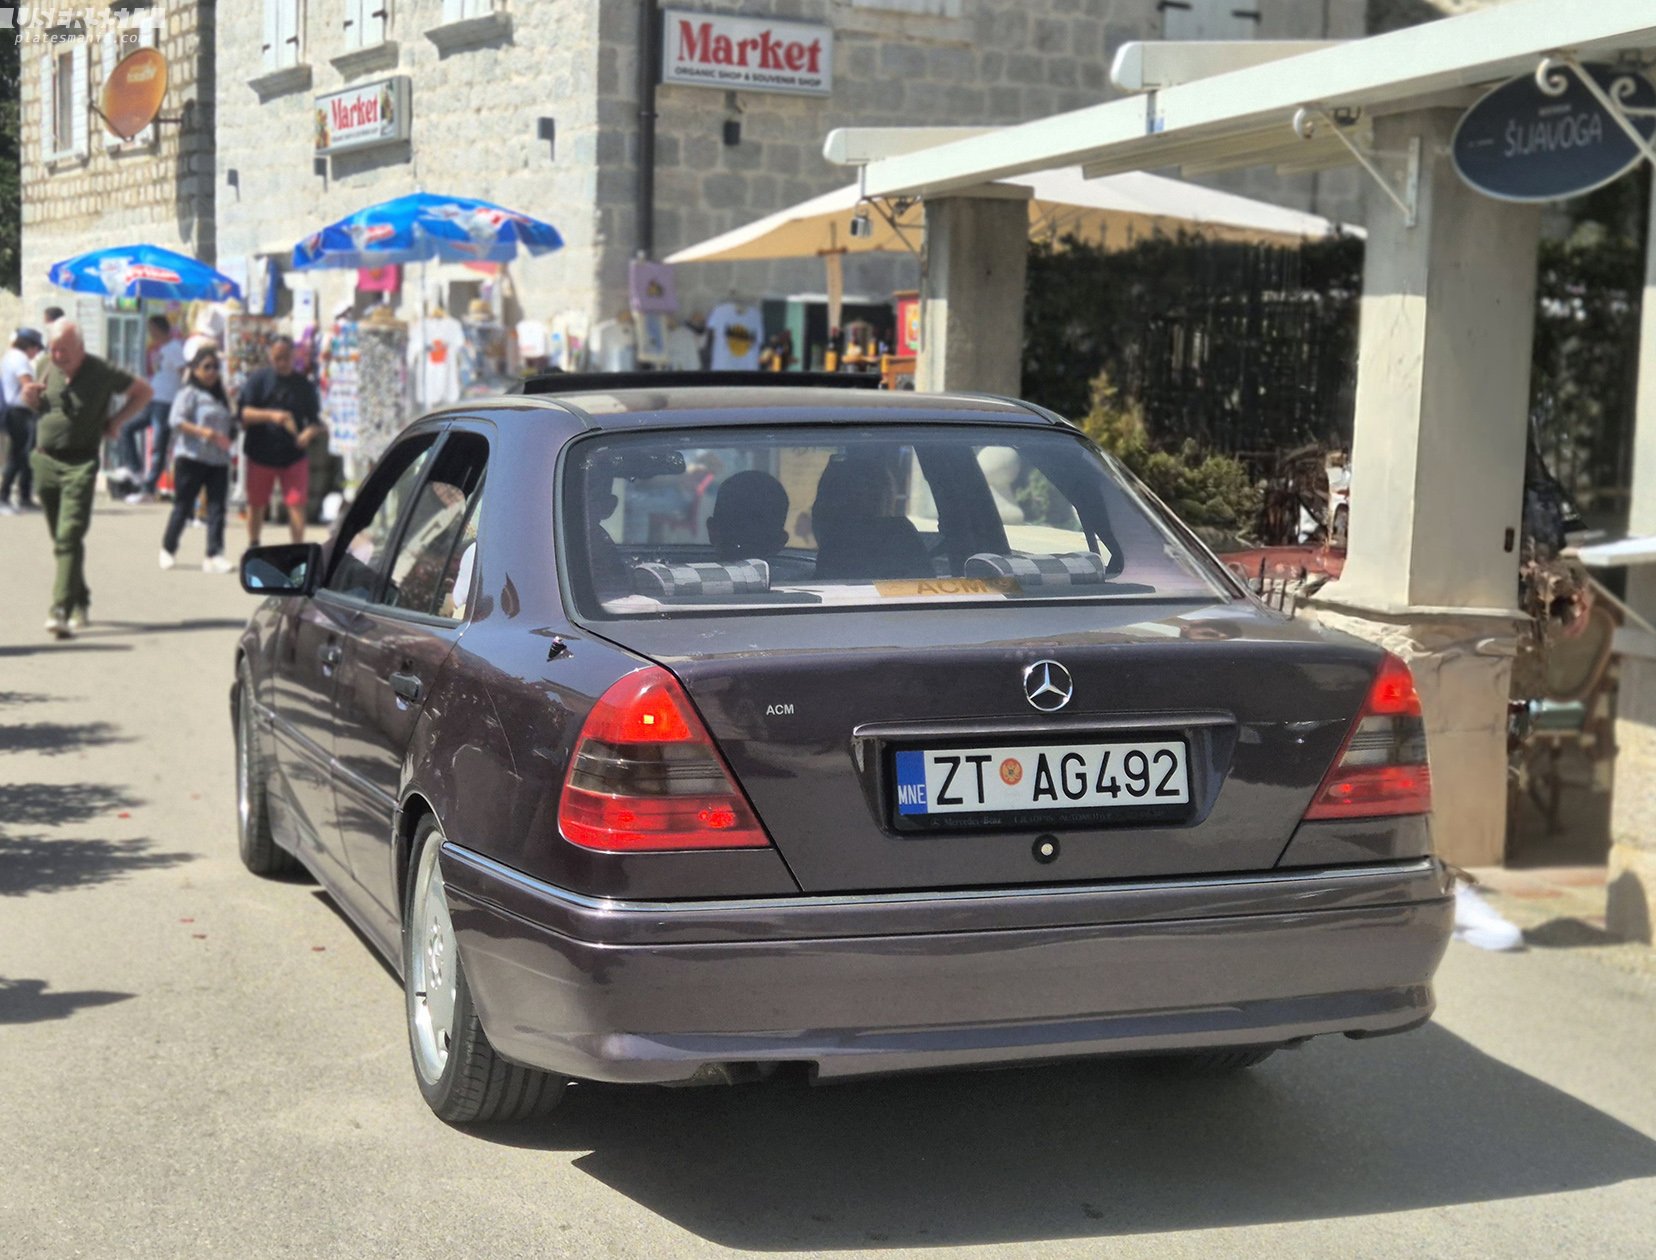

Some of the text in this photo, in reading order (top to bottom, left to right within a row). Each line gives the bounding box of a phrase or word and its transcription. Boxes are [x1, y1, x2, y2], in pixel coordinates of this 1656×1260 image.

[677, 20, 821, 74] Market
[675, 66, 822, 87] ORGANIC SHOP & SOUVENIR SHOP
[331, 94, 378, 130] Market
[917, 579, 987, 595] ACM
[766, 704, 794, 716] ACM
[933, 755, 992, 805] ZT
[898, 784, 926, 805] MNE
